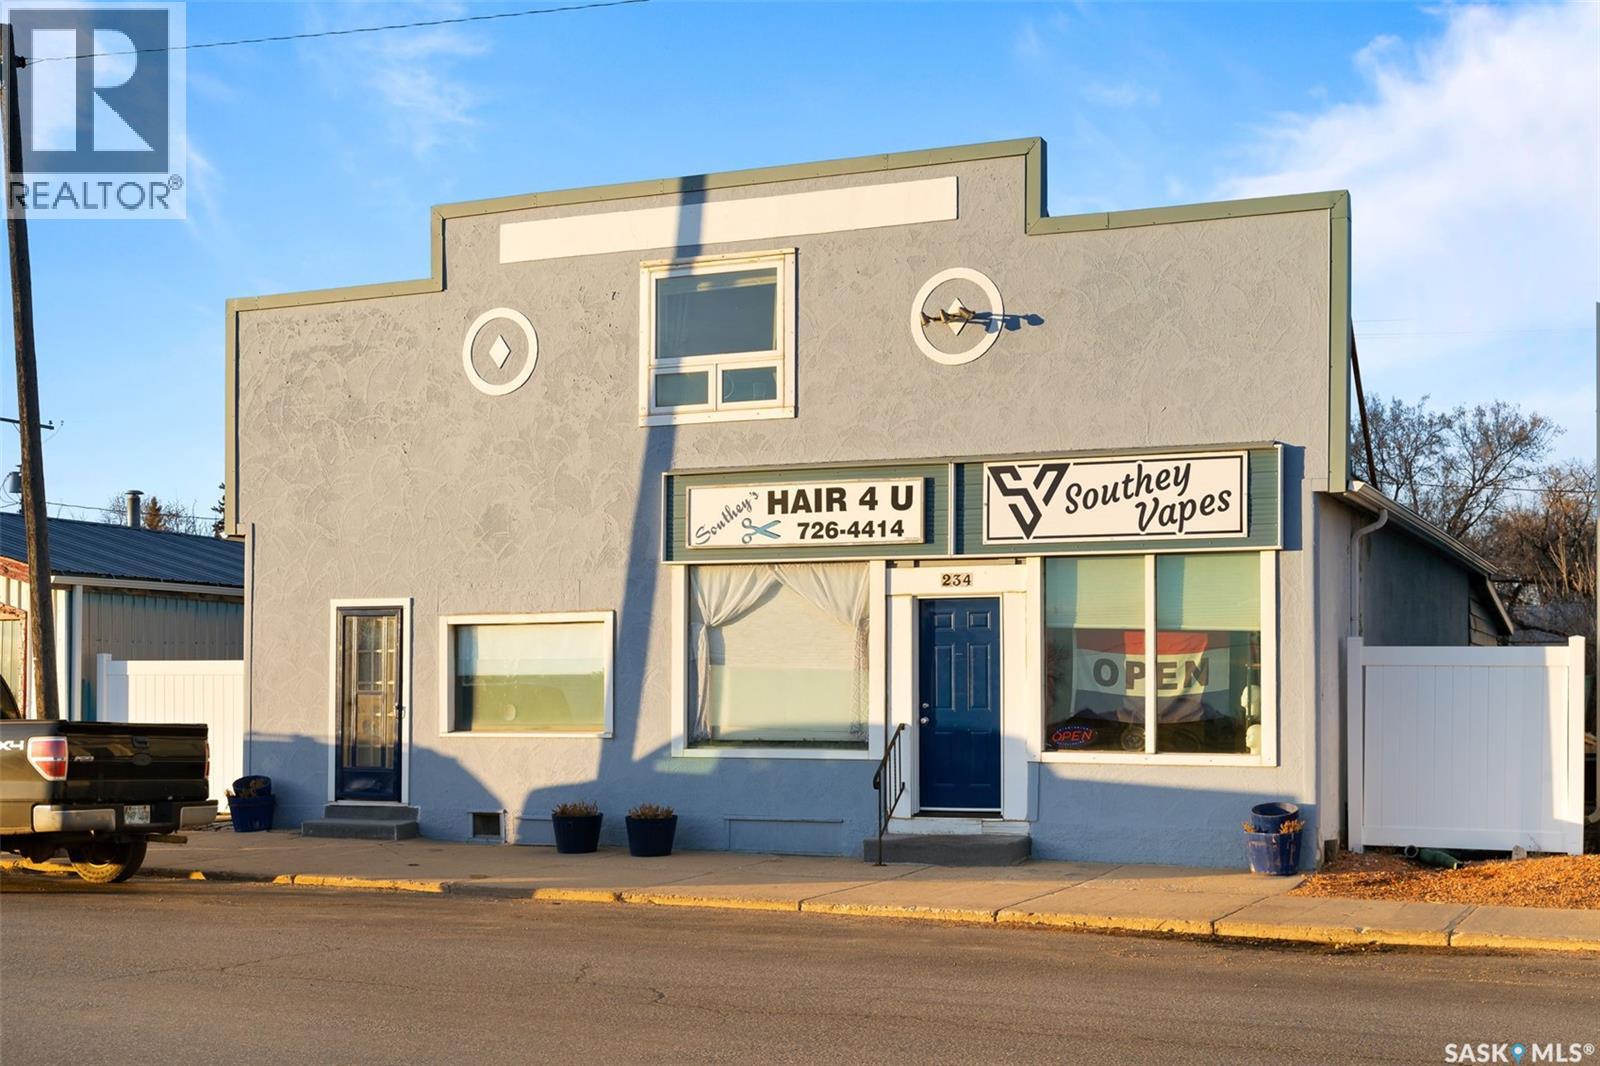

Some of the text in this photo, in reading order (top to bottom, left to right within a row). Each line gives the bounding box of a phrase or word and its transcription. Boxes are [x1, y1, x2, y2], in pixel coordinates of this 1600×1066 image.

[767, 485, 913, 515] HAIR 4 U
[1065, 460, 1191, 514] Southey
[695, 491, 759, 545] Southey's
[1135, 489, 1232, 533] Vapes
[797, 519, 904, 540] 726-4414
[942, 573, 971, 586] 234
[1093, 657, 1209, 690] OPEN
[1052, 729, 1092, 742] OPEN
